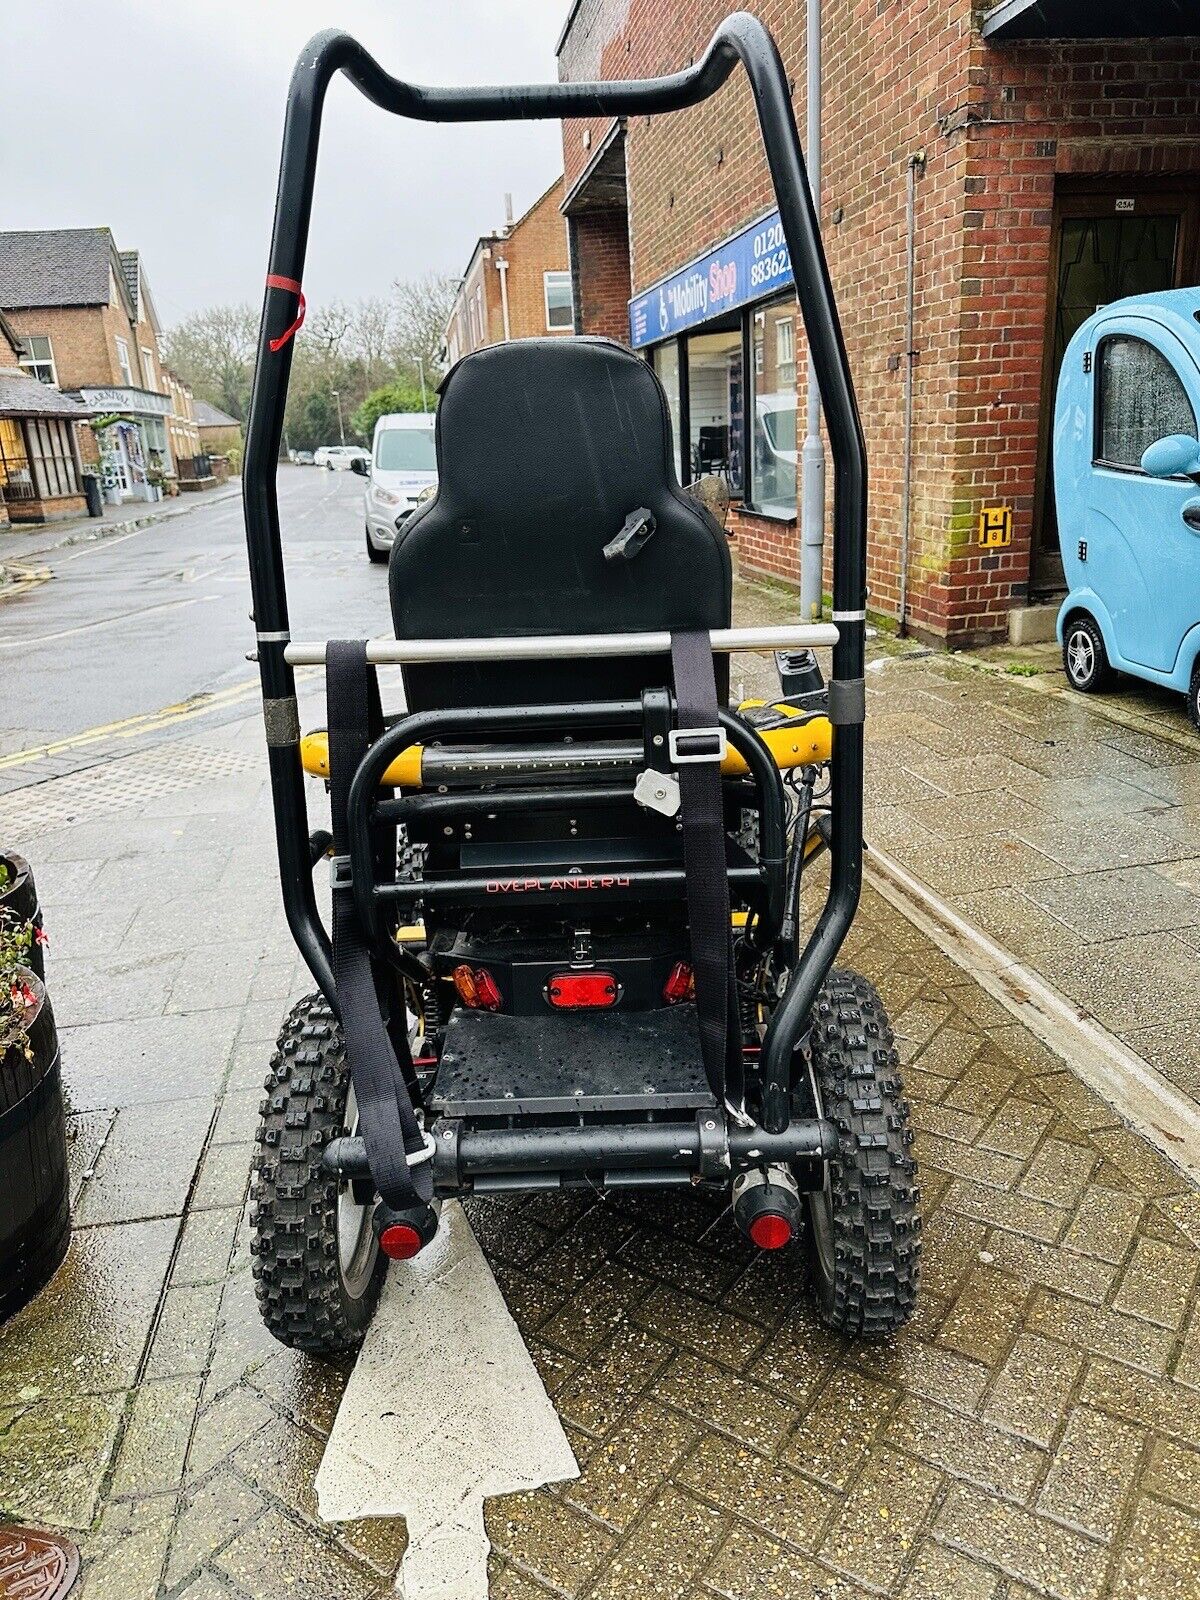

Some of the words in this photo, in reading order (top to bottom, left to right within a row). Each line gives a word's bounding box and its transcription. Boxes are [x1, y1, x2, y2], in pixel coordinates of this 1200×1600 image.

[754, 223, 787, 258] 0120
[673, 273, 708, 319] Mobility
[709, 260, 737, 303] Shop
